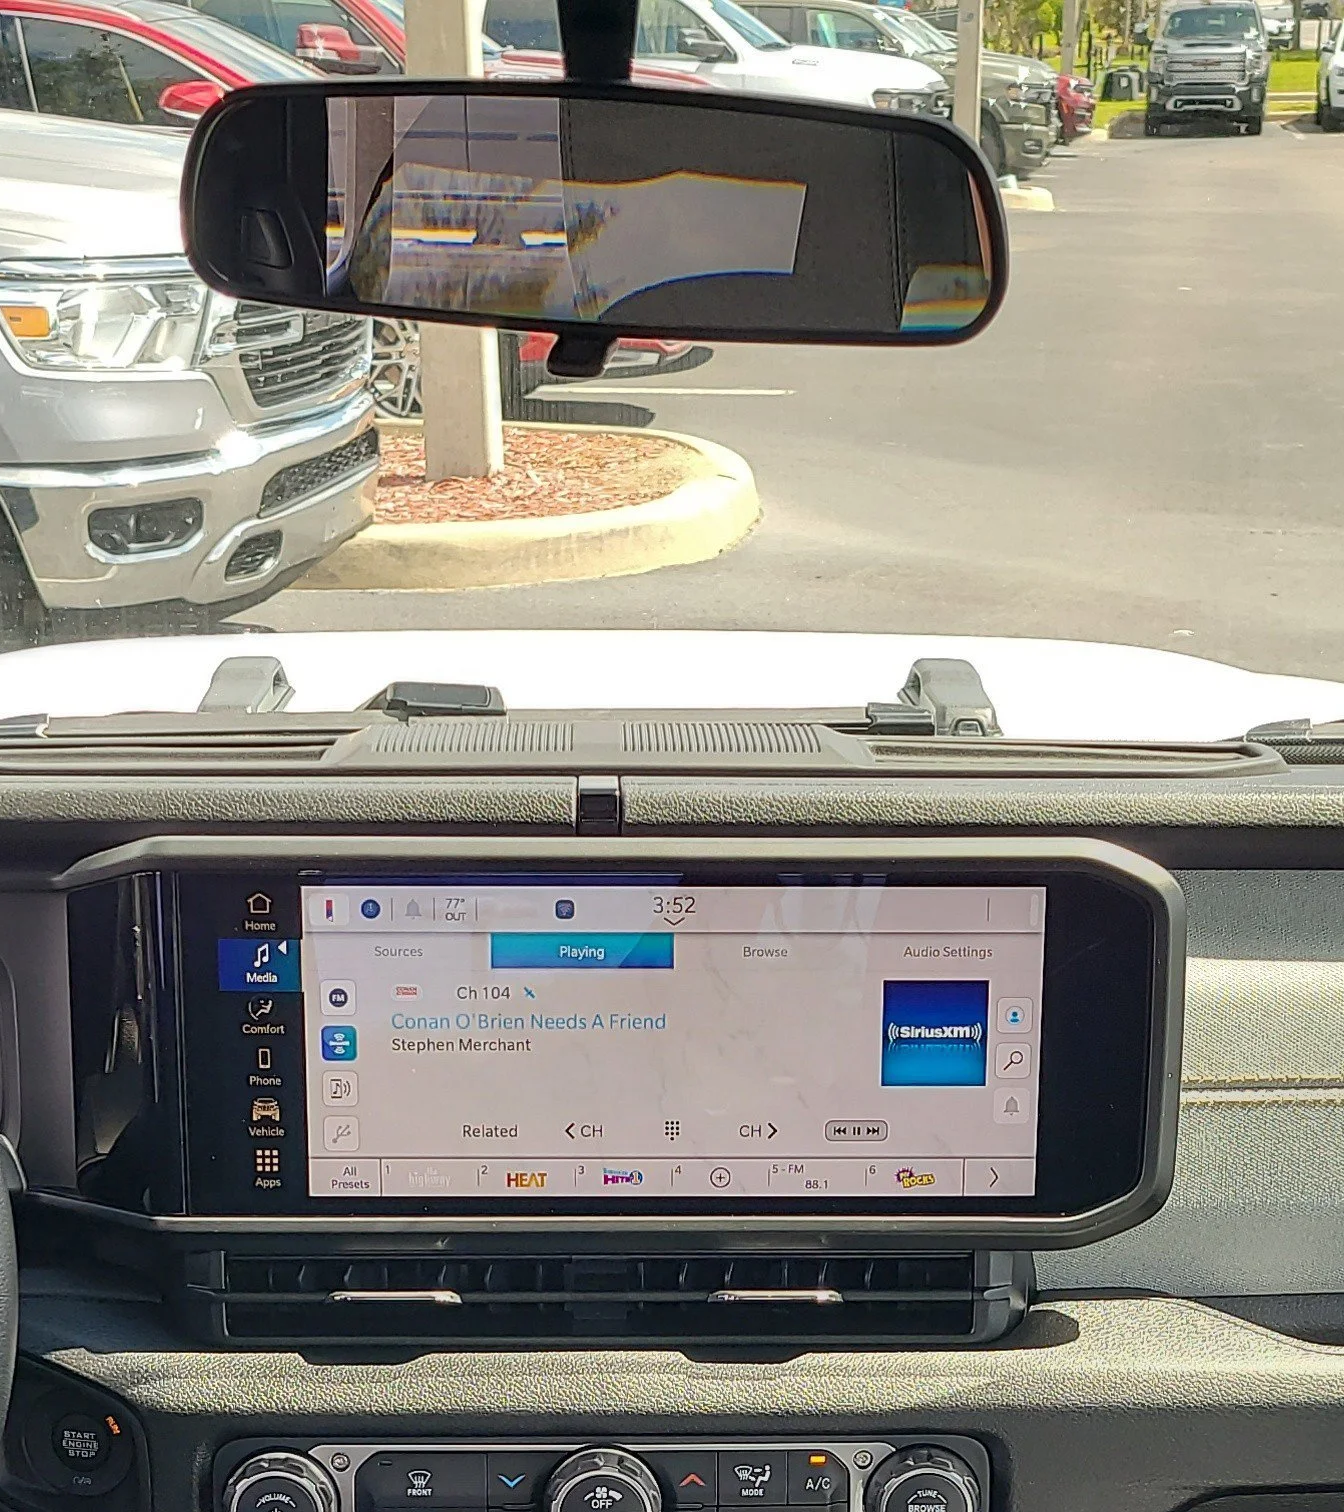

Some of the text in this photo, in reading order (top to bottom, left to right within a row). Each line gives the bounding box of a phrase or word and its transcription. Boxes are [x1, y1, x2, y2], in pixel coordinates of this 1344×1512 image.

[653, 896, 696, 914] 3:52
[445, 912, 466, 921] OUT
[244, 920, 276, 931] Home
[374, 945, 423, 957] Sources
[560, 945, 605, 960] Playing
[742, 946, 788, 958] Browse
[903, 945, 993, 960] Audio Settings
[246, 971, 278, 983] Media
[331, 993, 346, 1003] FM
[457, 986, 511, 1000] Ch 104
[391, 1012, 667, 1030] Conan O'Brien Needs A Friend
[242, 1023, 285, 1035] Comfort
[900, 1025, 971, 1040] SiriusXM
[391, 1038, 532, 1053] Stephen Merchant
[249, 1075, 282, 1086] Phone
[248, 1126, 285, 1137] Vehicle
[462, 1124, 519, 1138] Related
[580, 1125, 604, 1138] CH
[739, 1125, 762, 1138] CH
[342, 1166, 357, 1176] All
[481, 1165, 489, 1175] 2
[578, 1165, 585, 1175] 3
[674, 1165, 682, 1175] 4
[772, 1164, 804, 1174] 5 FM
[869, 1164, 876, 1175] 6
[254, 1177, 281, 1190] Apps
[331, 1179, 370, 1189] Presets
[506, 1172, 547, 1188] HEAT
[805, 1179, 829, 1189] 88.1
[63, 1430, 96, 1440] START
[62, 1439, 99, 1450] ENGINE
[68, 1449, 96, 1458] STOP
[805, 1477, 831, 1490] A/C
[407, 1488, 433, 1497] FRONT
[741, 1488, 765, 1497] MODE
[916, 1489, 938, 1499] TUNE
[259, 1493, 292, 1504] VOLUME
[591, 1500, 613, 1509] OFF
